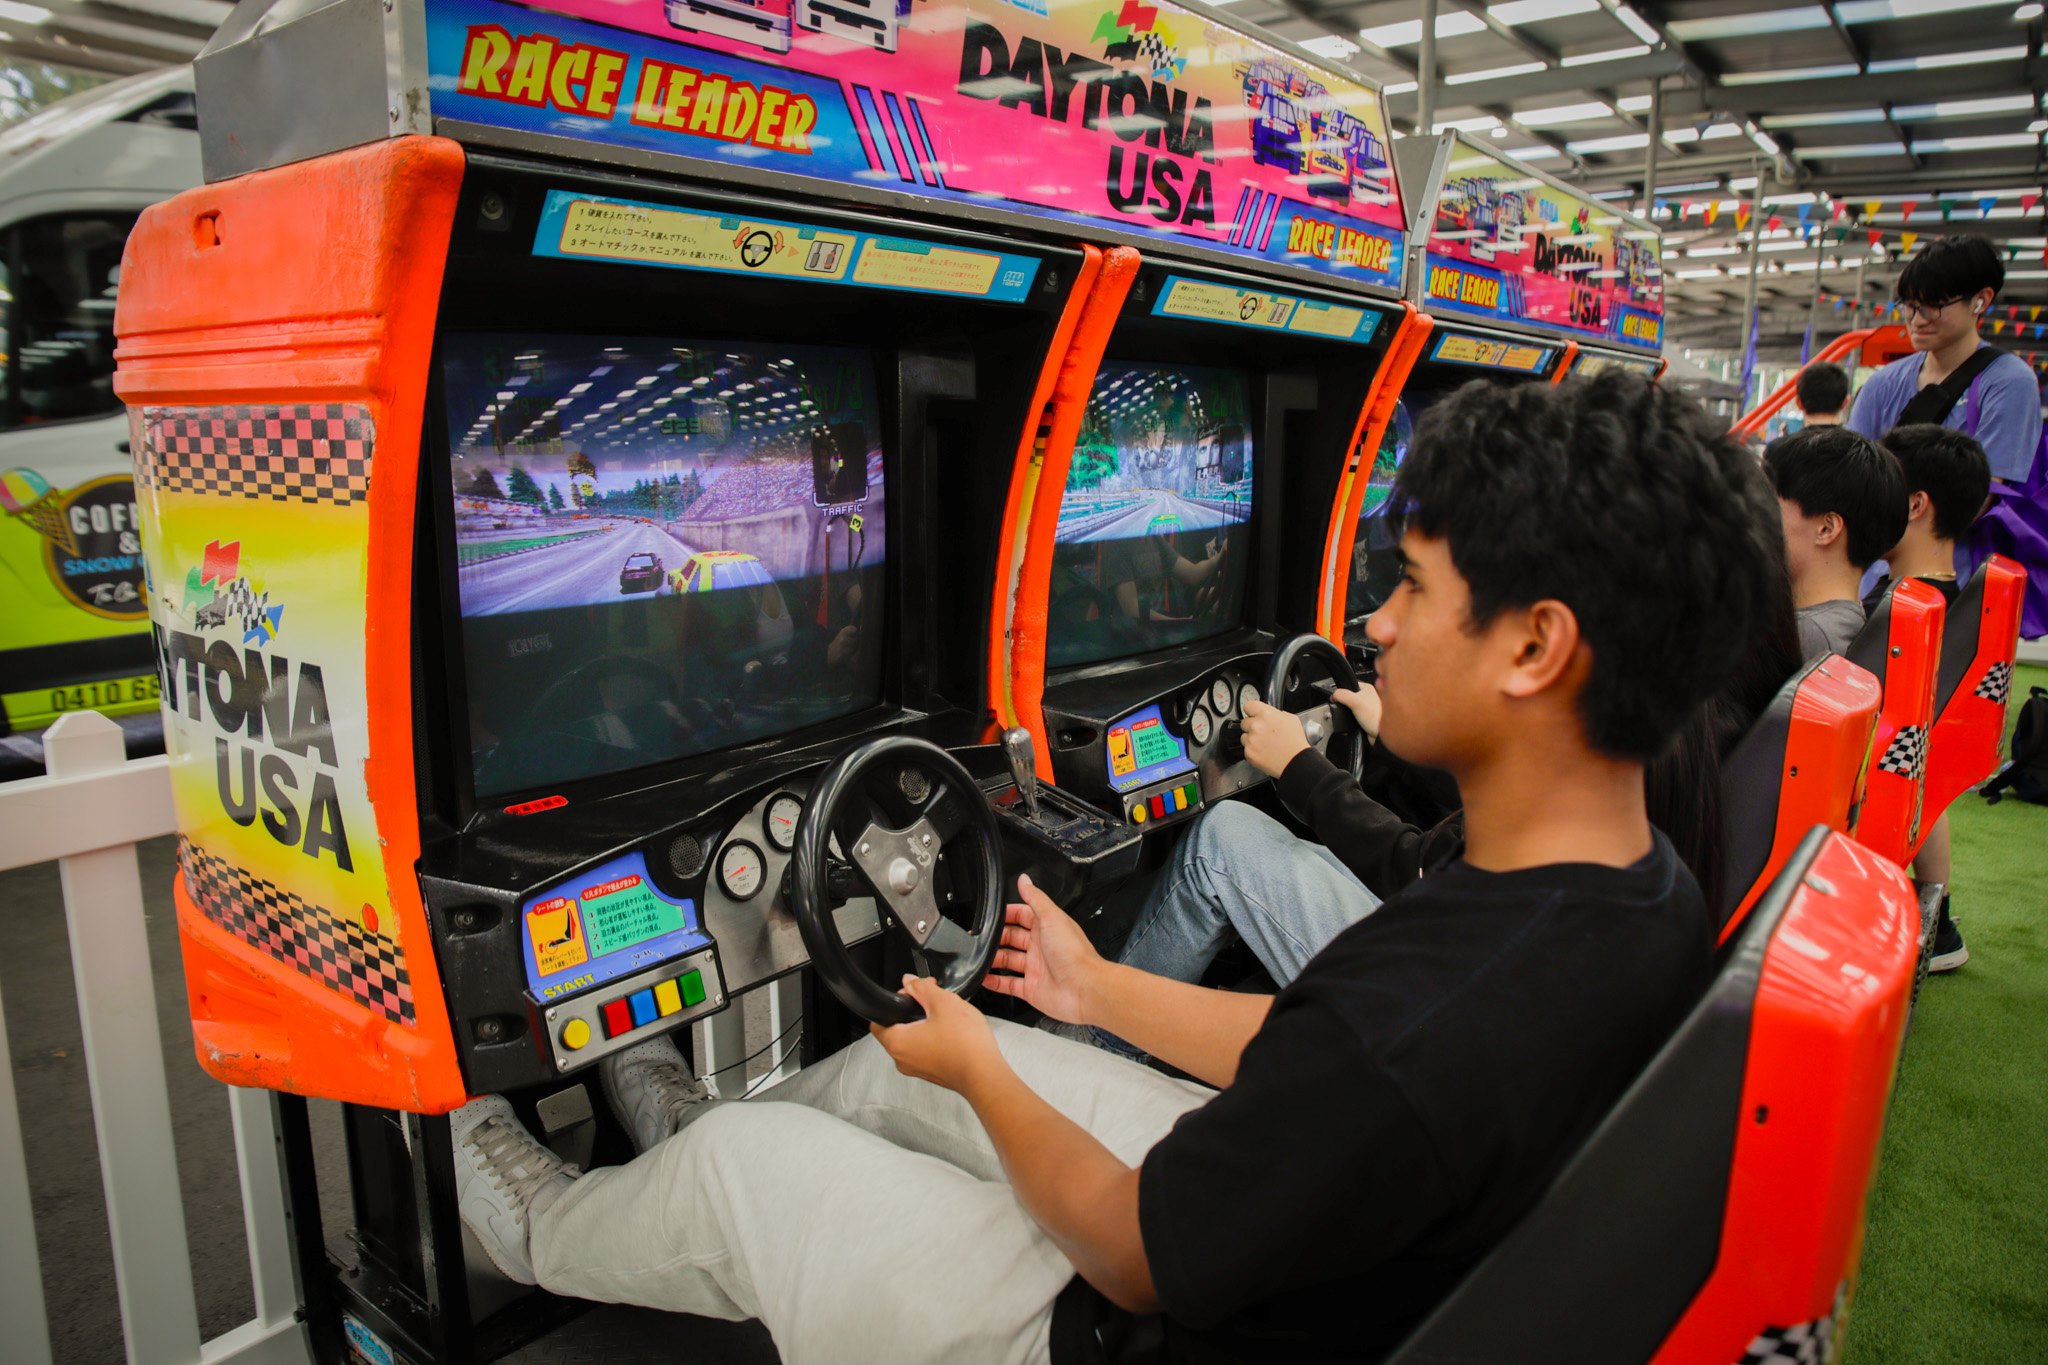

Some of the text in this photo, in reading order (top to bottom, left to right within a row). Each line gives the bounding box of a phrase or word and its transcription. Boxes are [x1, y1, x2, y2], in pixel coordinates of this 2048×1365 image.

[462, 28, 816, 152] RACE LEADER
[958, 16, 1215, 164] DAYTONA
[1106, 147, 1215, 230] USA
[571, 238, 576, 246] 3
[1288, 214, 1393, 272] RACE LEADER
[1533, 231, 1603, 289] DAYTONA
[1429, 265, 1499, 309] RACE LEADER
[1568, 287, 1602, 328] USA
[1622, 314, 1659, 342] RACE LEADER
[821, 504, 863, 516] TRAFFIC
[119, 531, 140, 554] &
[63, 555, 135, 576] SNOW
[53, 681, 119, 711] 0410
[215, 736, 354, 874] USA
[543, 973, 595, 998] START
